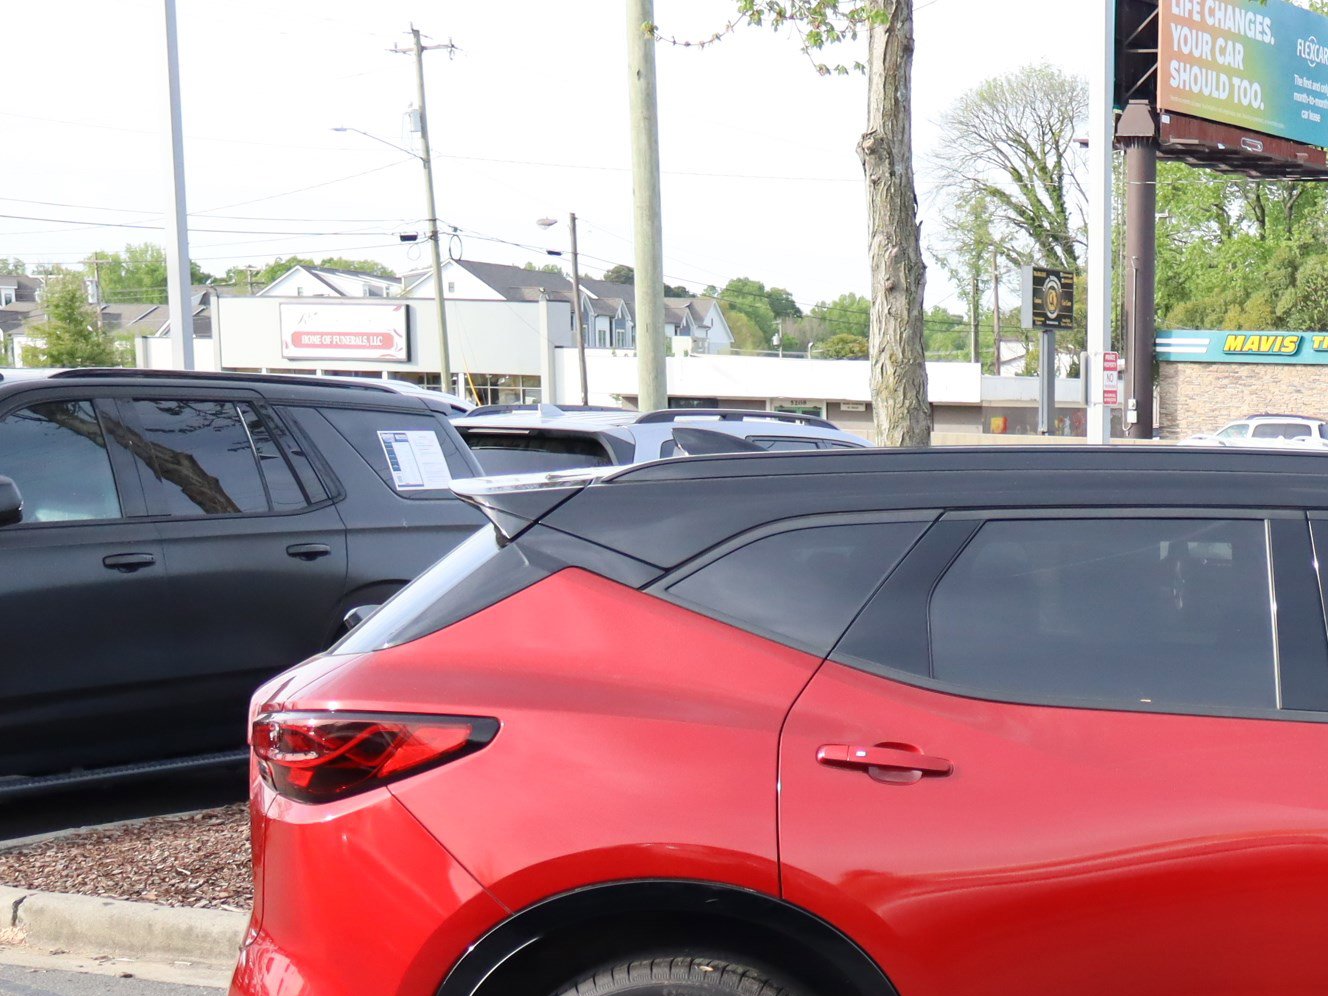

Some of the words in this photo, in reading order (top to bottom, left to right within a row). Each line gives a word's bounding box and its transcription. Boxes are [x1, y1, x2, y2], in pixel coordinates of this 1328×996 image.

[1171, 0, 1201, 22] LIFE
[1204, 0, 1275, 46] CHANGES.
[1170, 22, 1212, 61] YOUR
[1215, 37, 1244, 71] CAR
[1296, 38, 1328, 66] FLEXCAR
[1169, 59, 1230, 100] SHOULD
[1232, 75, 1265, 111] TOO.
[322, 335, 333, 345] OF
[1223, 334, 1300, 354] MAVIS
